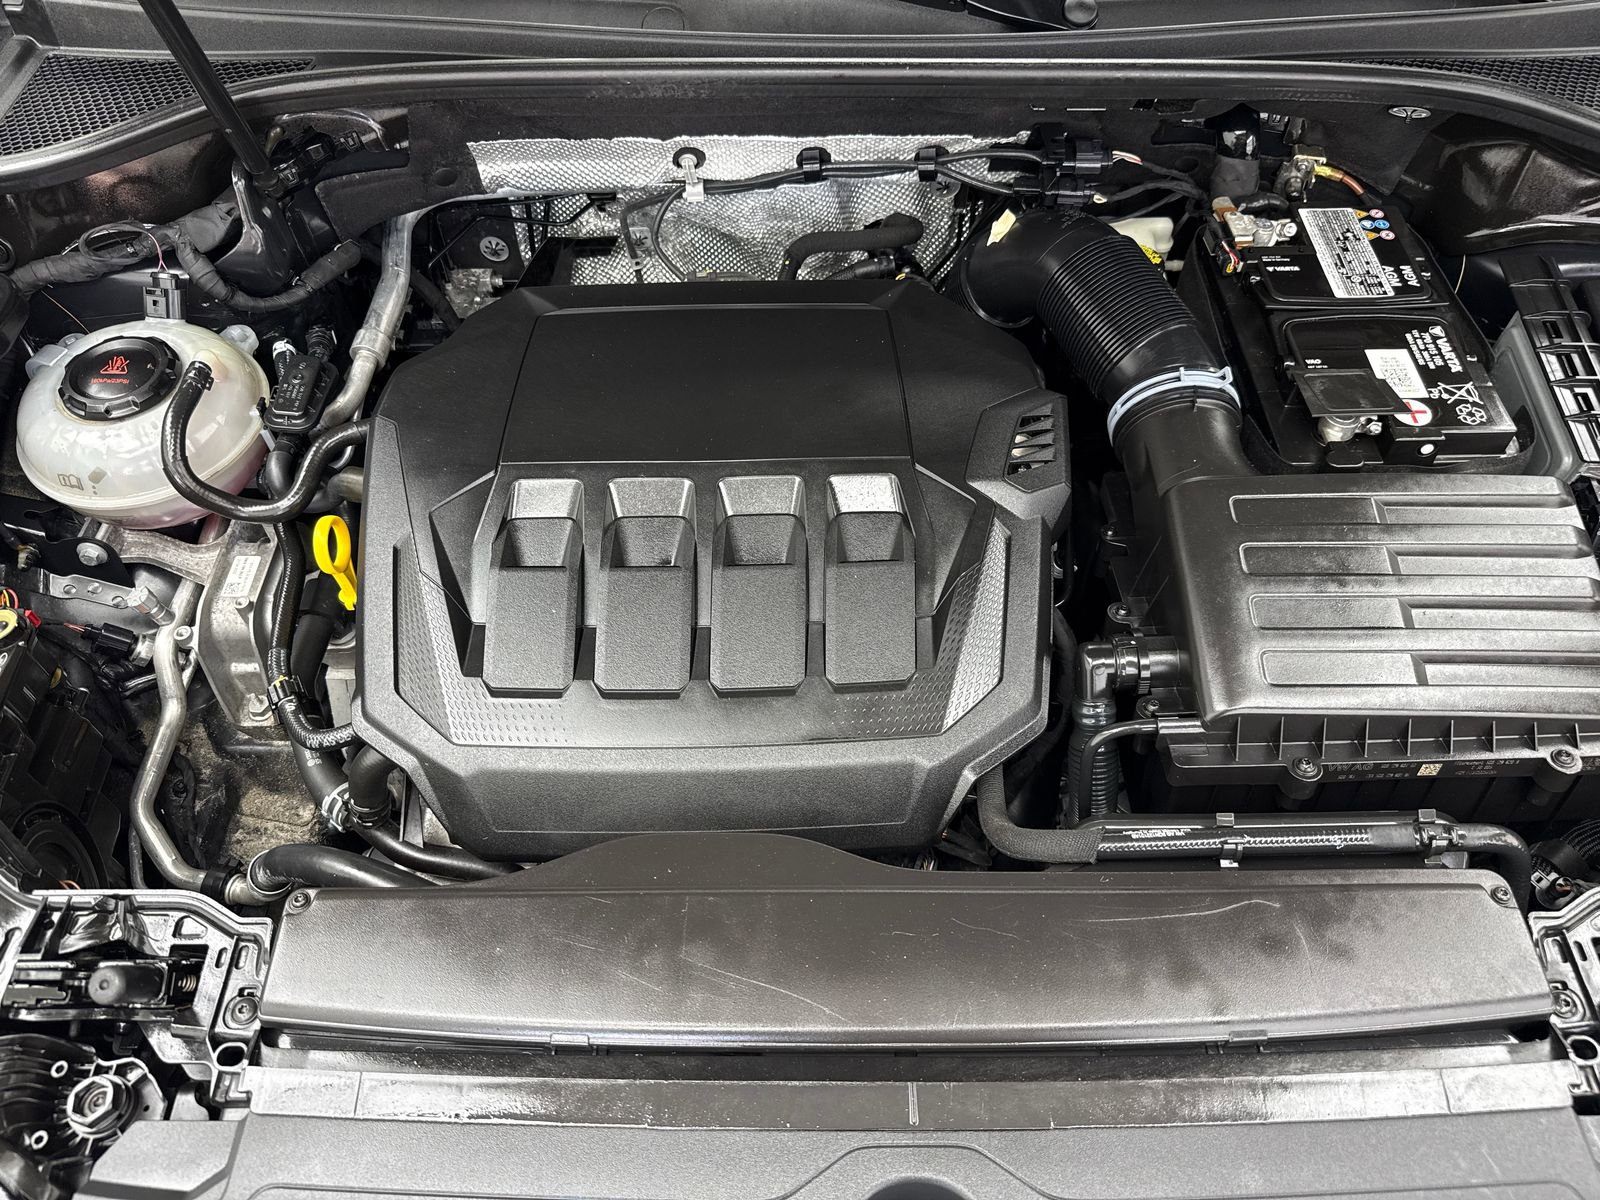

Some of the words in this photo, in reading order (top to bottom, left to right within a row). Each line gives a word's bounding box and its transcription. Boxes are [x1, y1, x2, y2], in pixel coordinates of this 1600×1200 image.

[1381, 265, 1402, 287] AGM
[1400, 265, 1421, 287] AGM
[1436, 337, 1463, 373] VARTA
[1427, 387, 1441, 399] Pb
